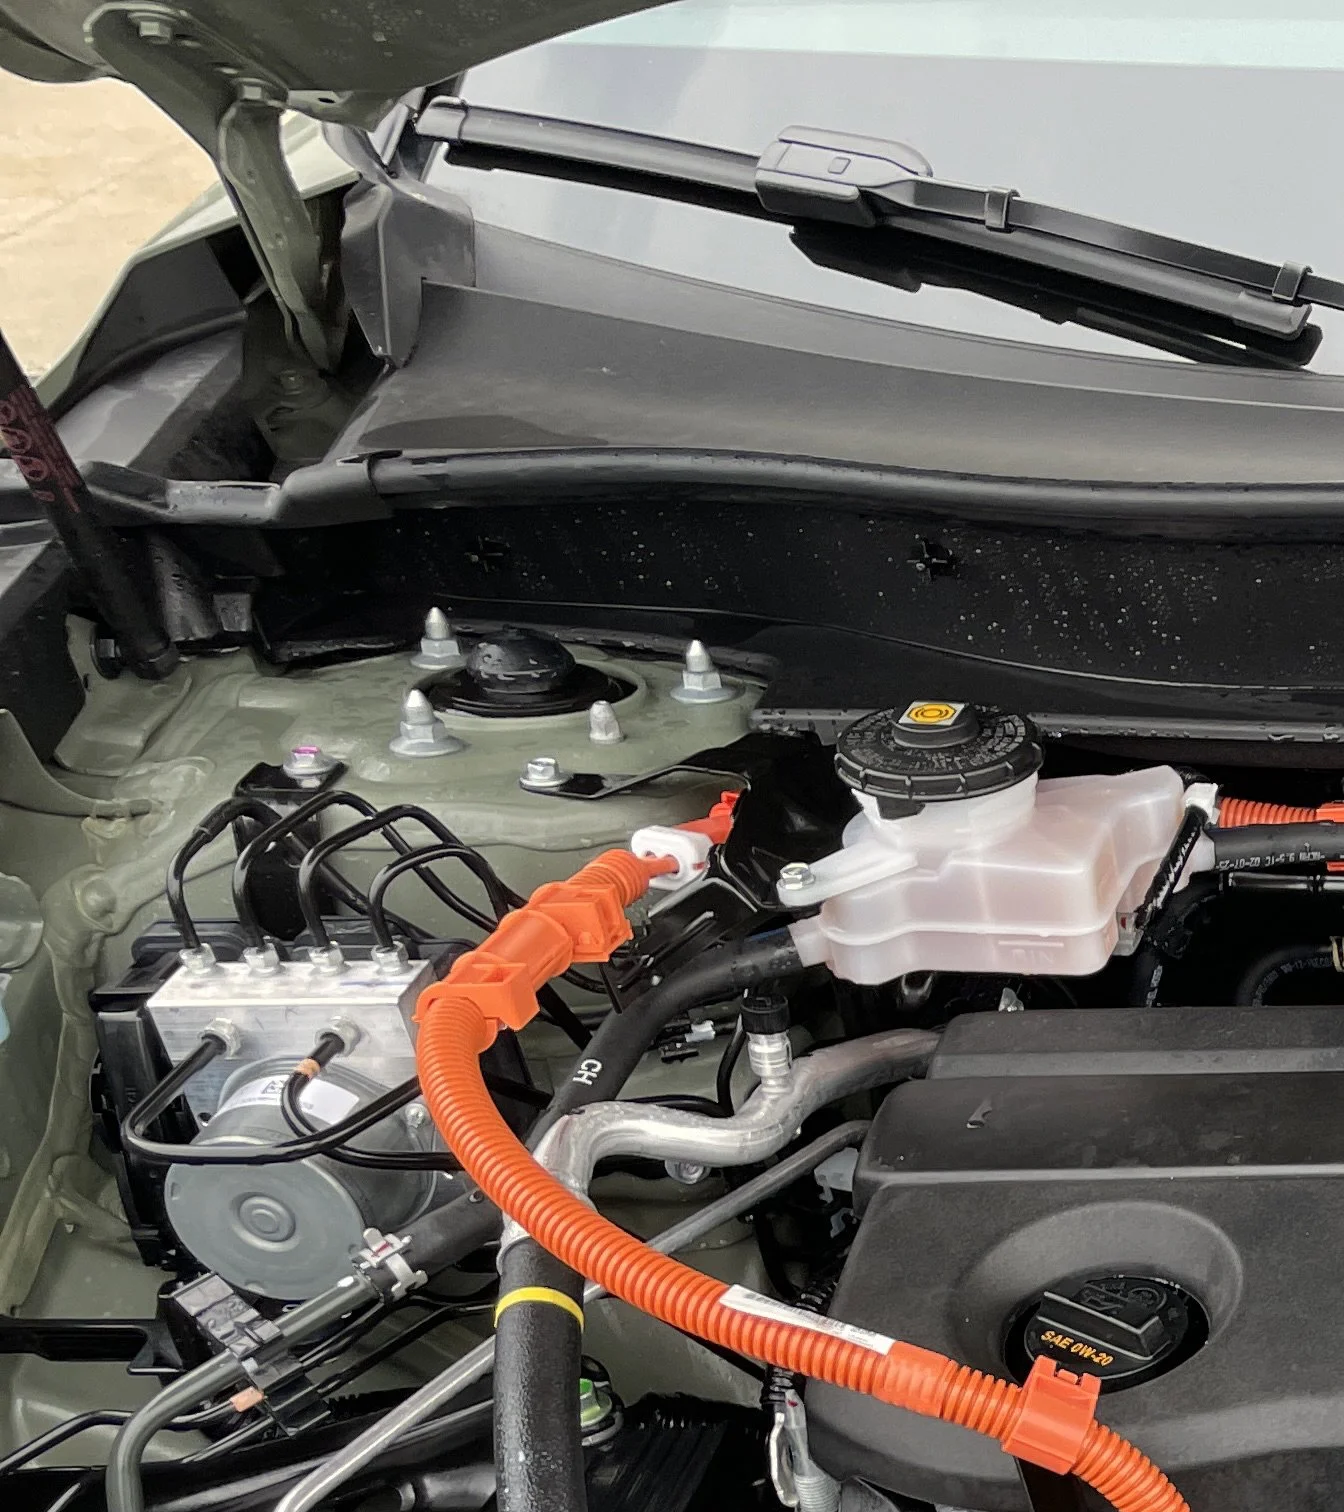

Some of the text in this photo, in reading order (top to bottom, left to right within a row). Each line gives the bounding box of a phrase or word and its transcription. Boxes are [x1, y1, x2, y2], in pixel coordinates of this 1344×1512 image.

[572, 1058, 603, 1086] CH
[1040, 1330, 1114, 1367] SAE 0W-20
